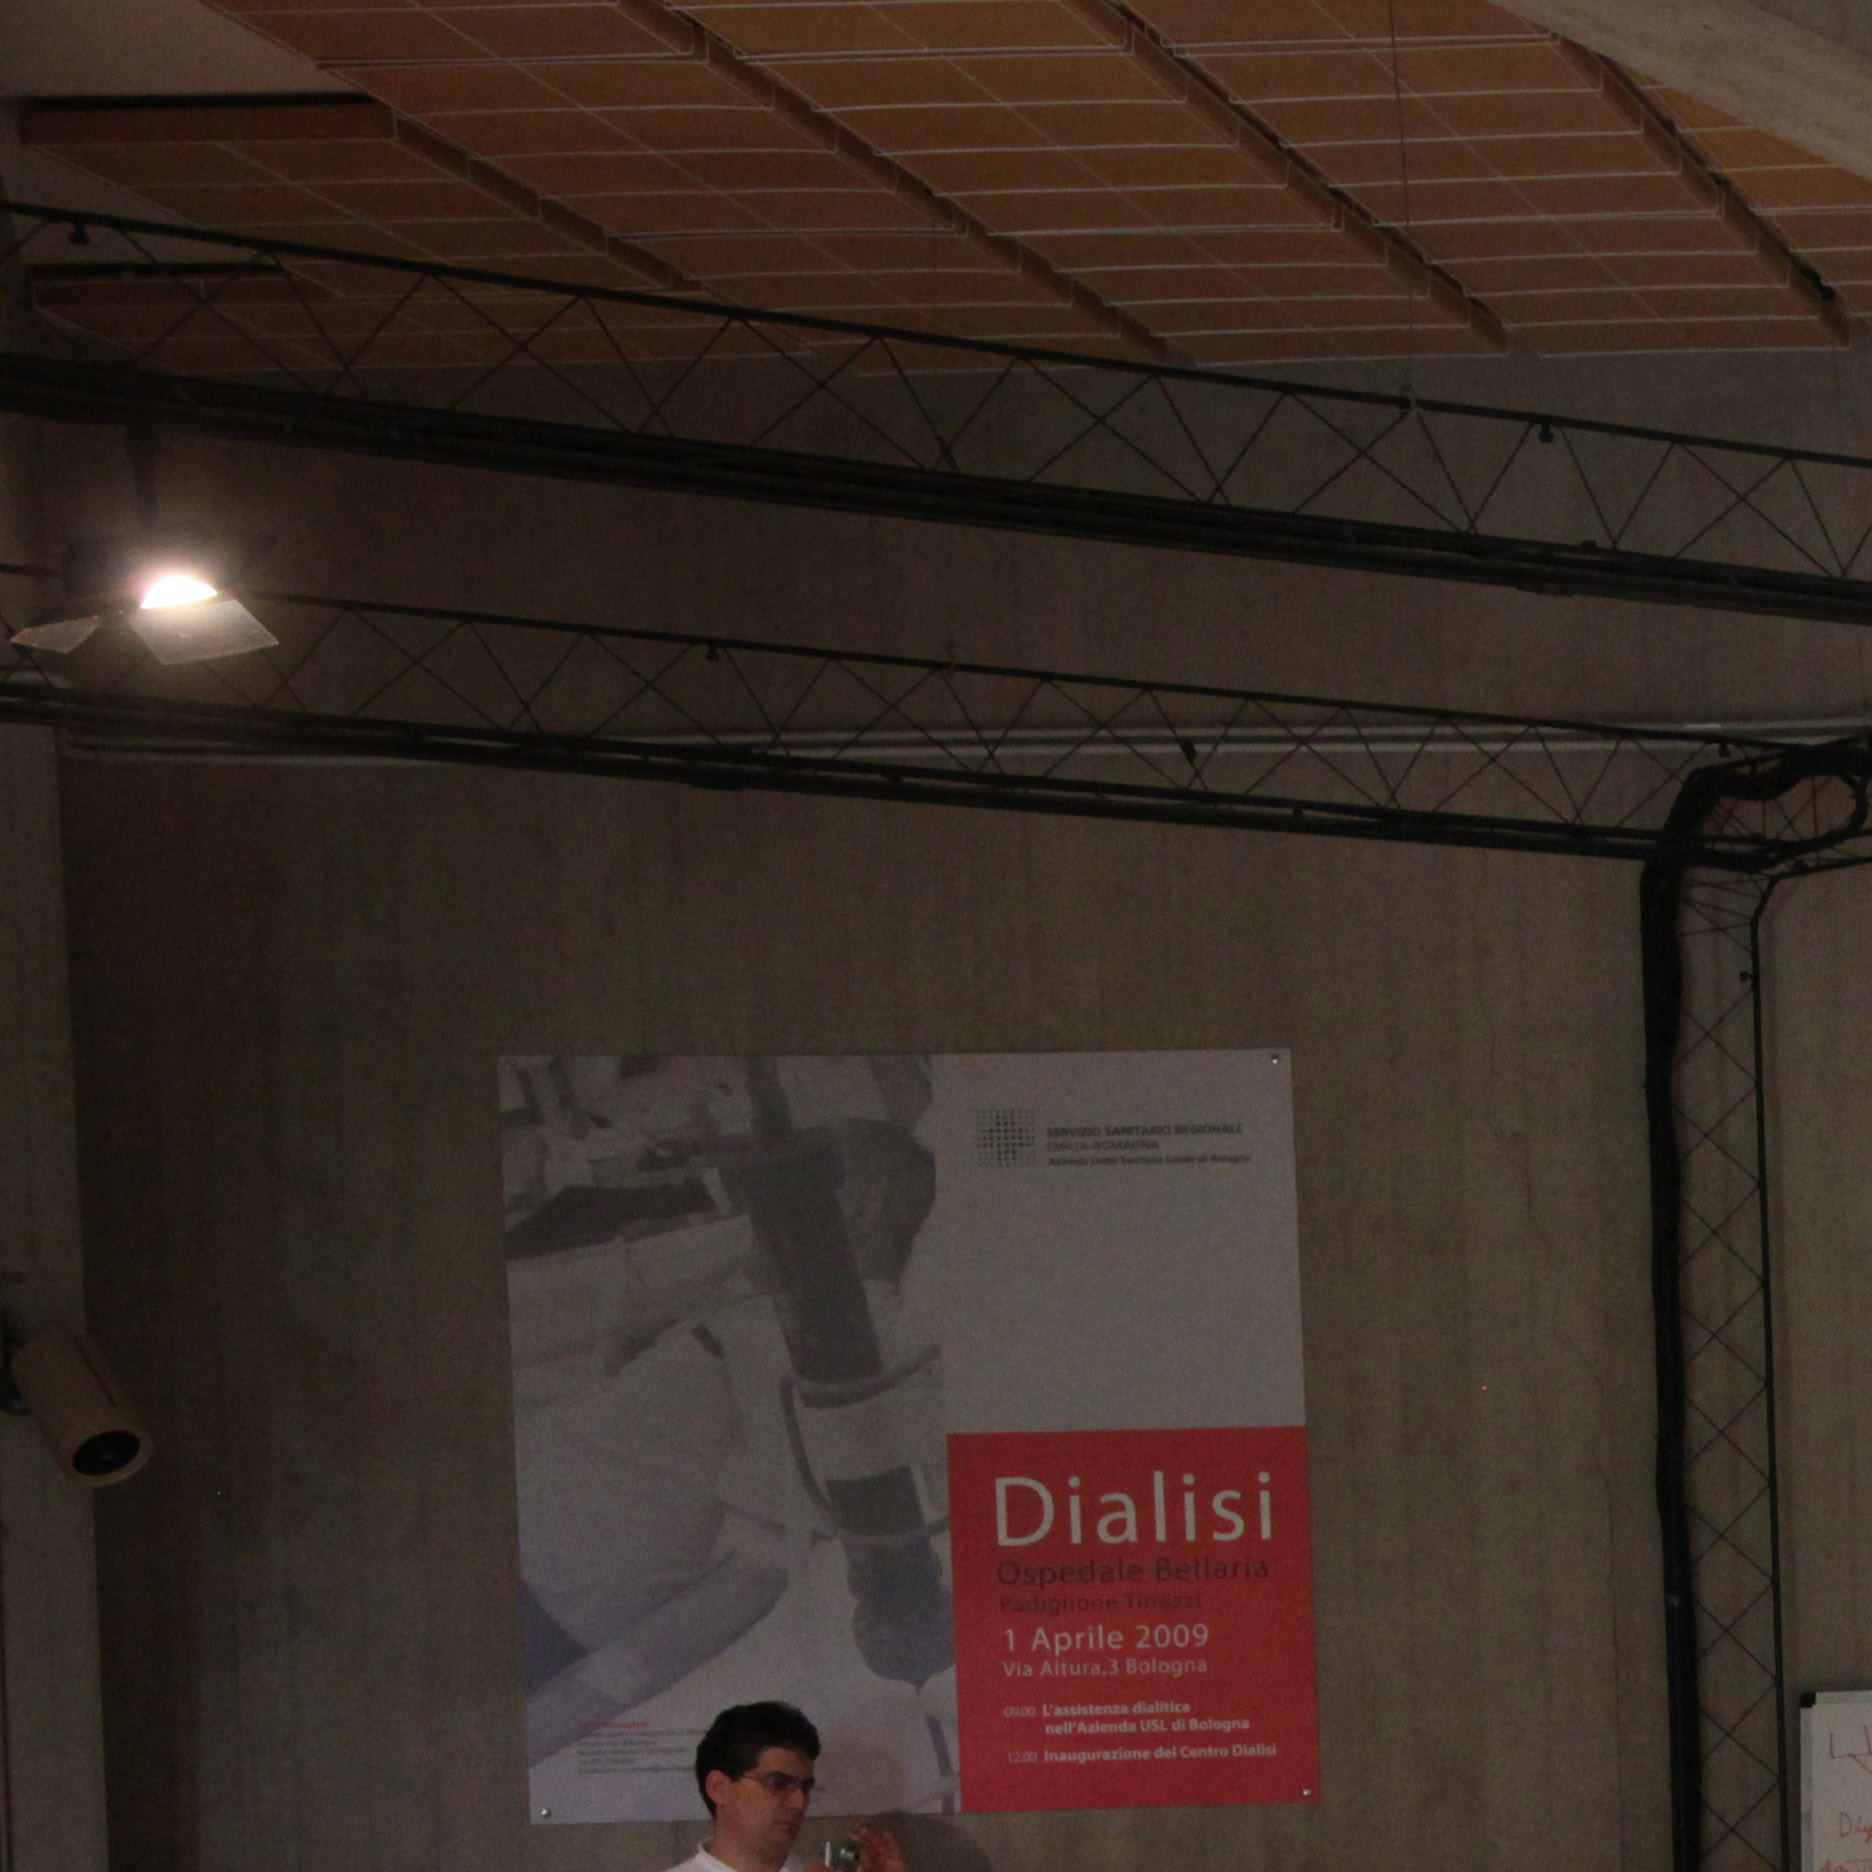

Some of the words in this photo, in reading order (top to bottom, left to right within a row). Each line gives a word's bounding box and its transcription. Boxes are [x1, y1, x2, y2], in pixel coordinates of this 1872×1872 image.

[1104, 1124, 1171, 1136] SANITARIO
[995, 1470, 1272, 1546] Dialisi
[998, 1557, 1145, 1590] Ospedale
[1155, 1557, 1270, 1581] Bellaria
[1005, 1629, 1014, 1652] 1
[1031, 1625, 1124, 1655] Aprile
[1136, 1623, 1209, 1649] 2009
[1002, 1661, 1034, 1678] Via
[1126, 1658, 1208, 1678] Bologna
[1132, 1700, 1190, 1715] dialitica
[1140, 1719, 1168, 1732] USL
[1171, 1718, 1185, 1731] di
[1190, 1717, 1249, 1734] Bologna
[1044, 1747, 1152, 1765] Inaugurazione
[1154, 1746, 1176, 1759] del
[1180, 1745, 1228, 1758] Centro
[1233, 1743, 1277, 1757] Dialisi
